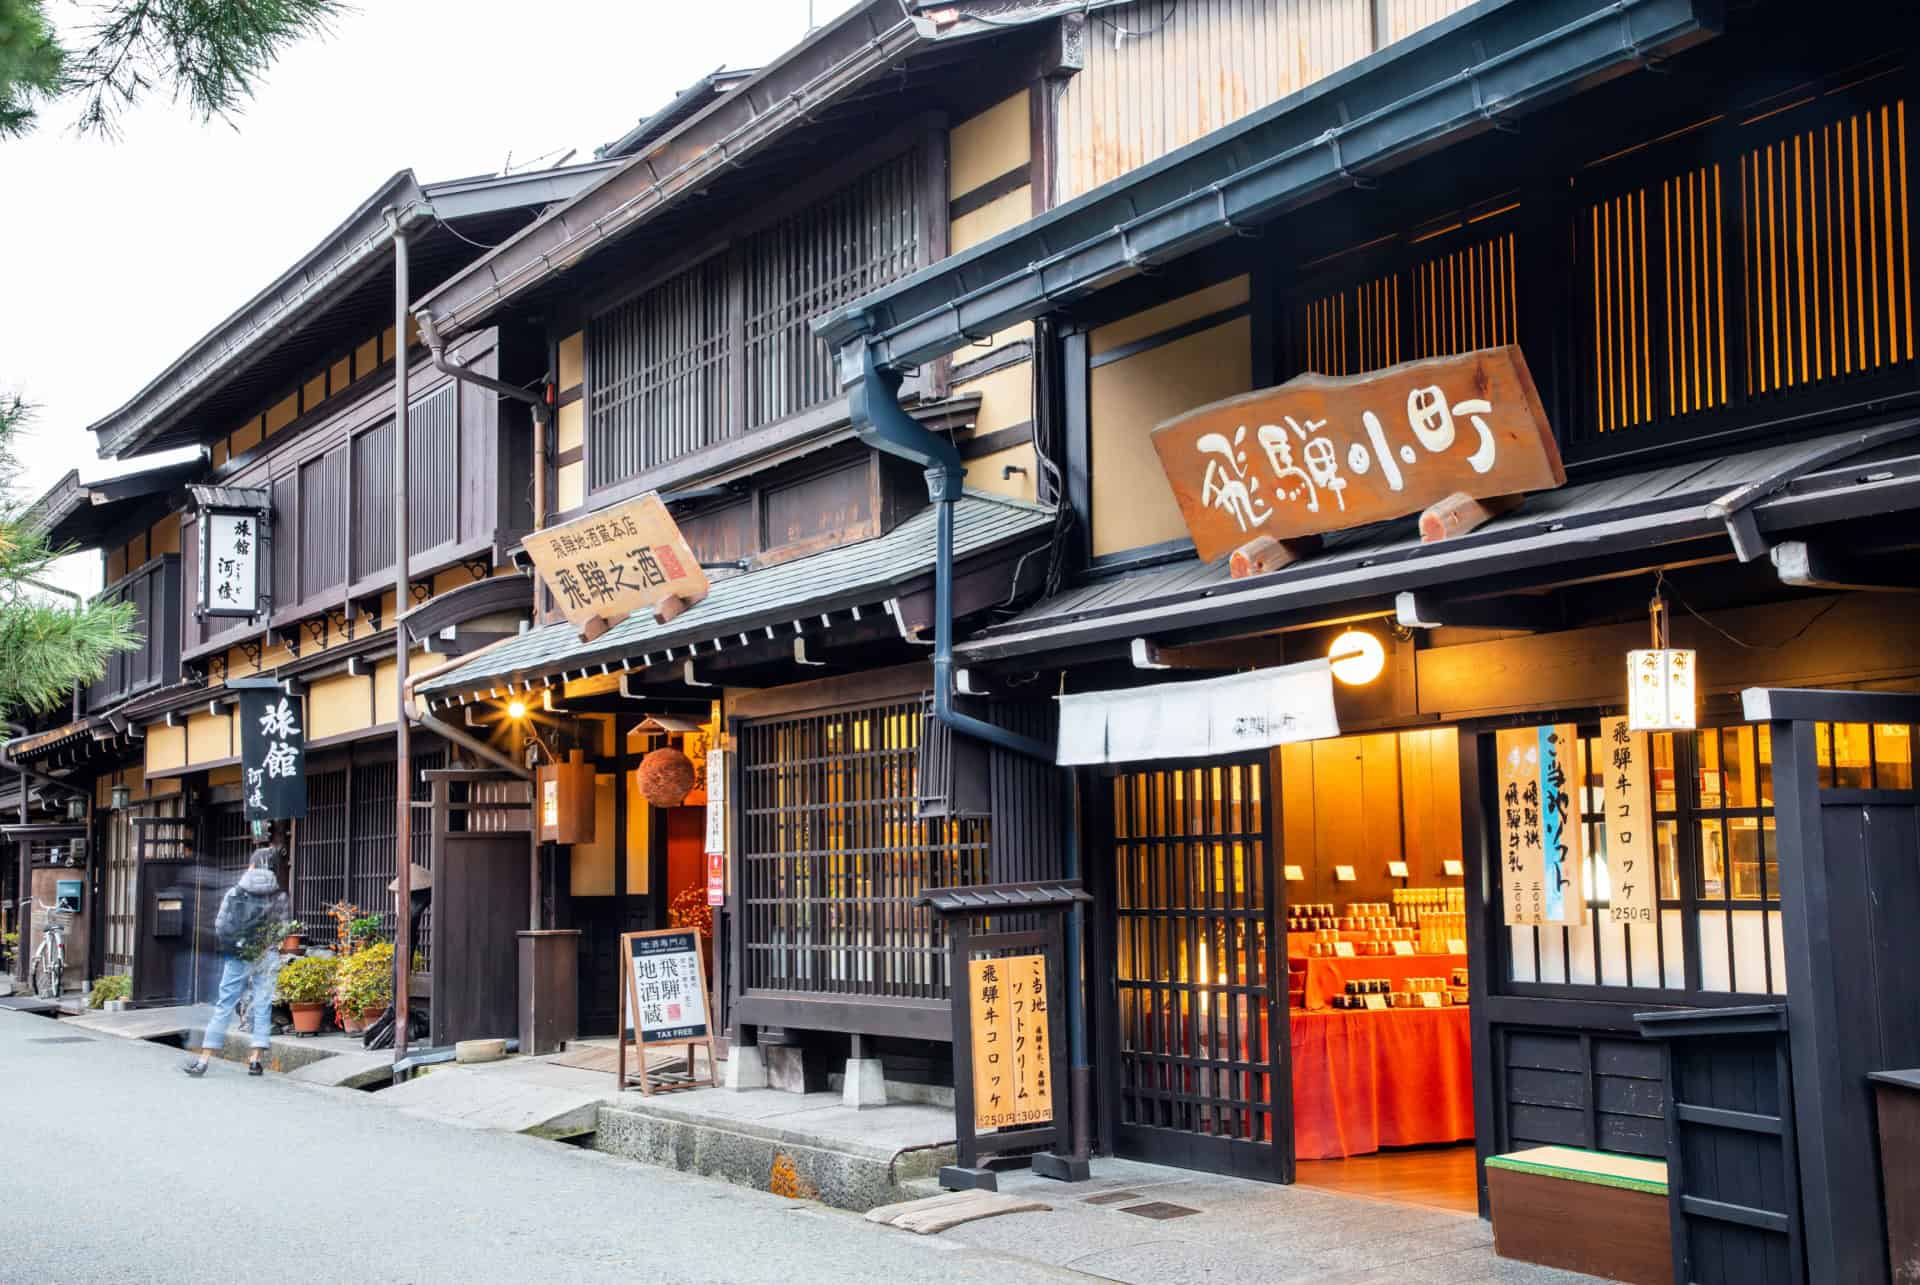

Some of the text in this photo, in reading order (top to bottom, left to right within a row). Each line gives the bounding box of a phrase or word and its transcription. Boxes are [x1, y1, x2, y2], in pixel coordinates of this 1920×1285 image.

[234, 519, 252, 556] 旅館
[258, 697, 301, 779] 旅館
[656, 1027, 694, 1039] TAX FREE
[1012, 982, 1029, 1100] ソフトクリーム
